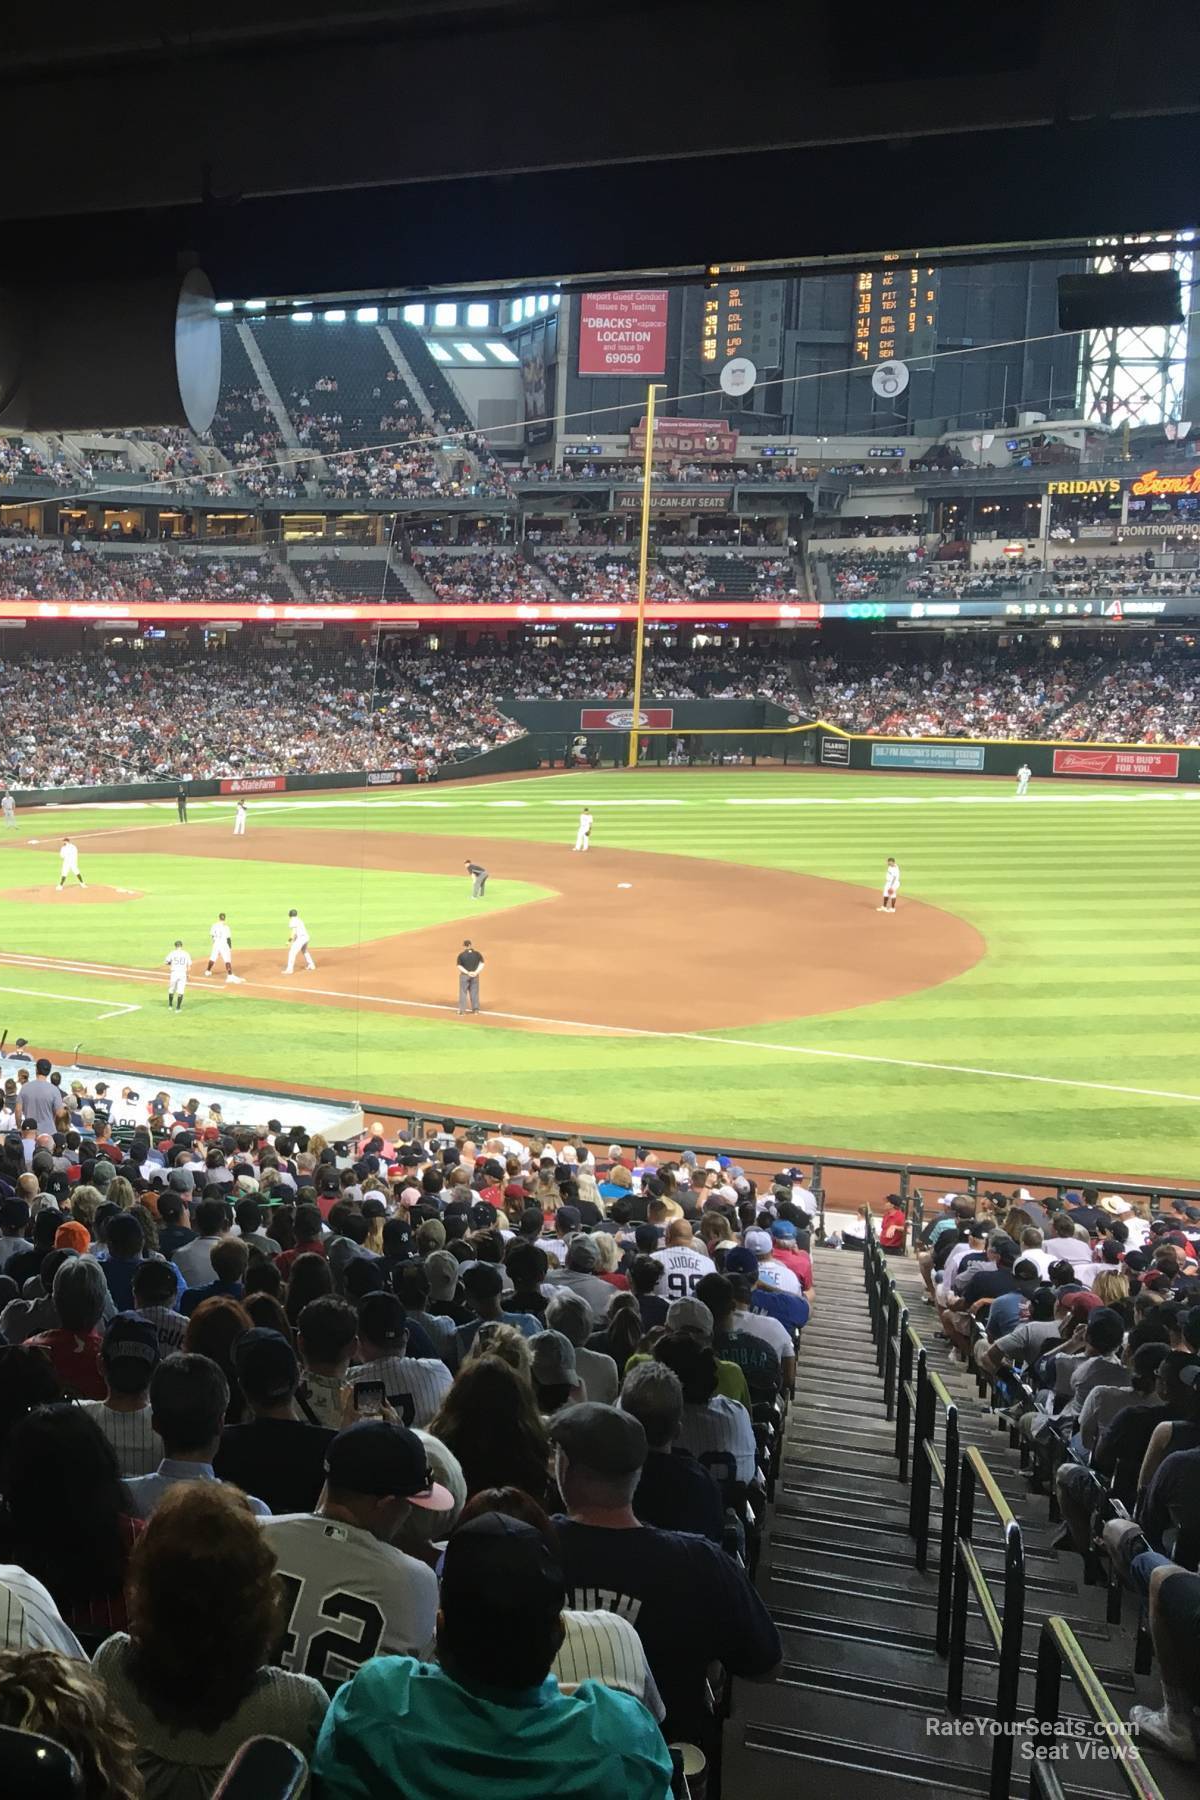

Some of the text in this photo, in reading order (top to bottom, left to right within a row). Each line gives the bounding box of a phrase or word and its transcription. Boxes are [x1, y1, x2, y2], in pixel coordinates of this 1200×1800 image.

[882, 291, 897, 301] PIT
[882, 301, 897, 310] TEX
[597, 331, 651, 342] LOCATION
[603, 343, 616, 351] and
[637, 343, 644, 351] to
[605, 353, 641, 364] 69050
[620, 498, 725, 507] ALL-YU-CAN-EAT SEATS
[1117, 524, 1200, 536] FRONTROWPHO
[1116, 755, 1161, 764] THIS BUD'S
[1115, 764, 1132, 772] FOR
[669, 1256, 701, 1271] JUDGE
